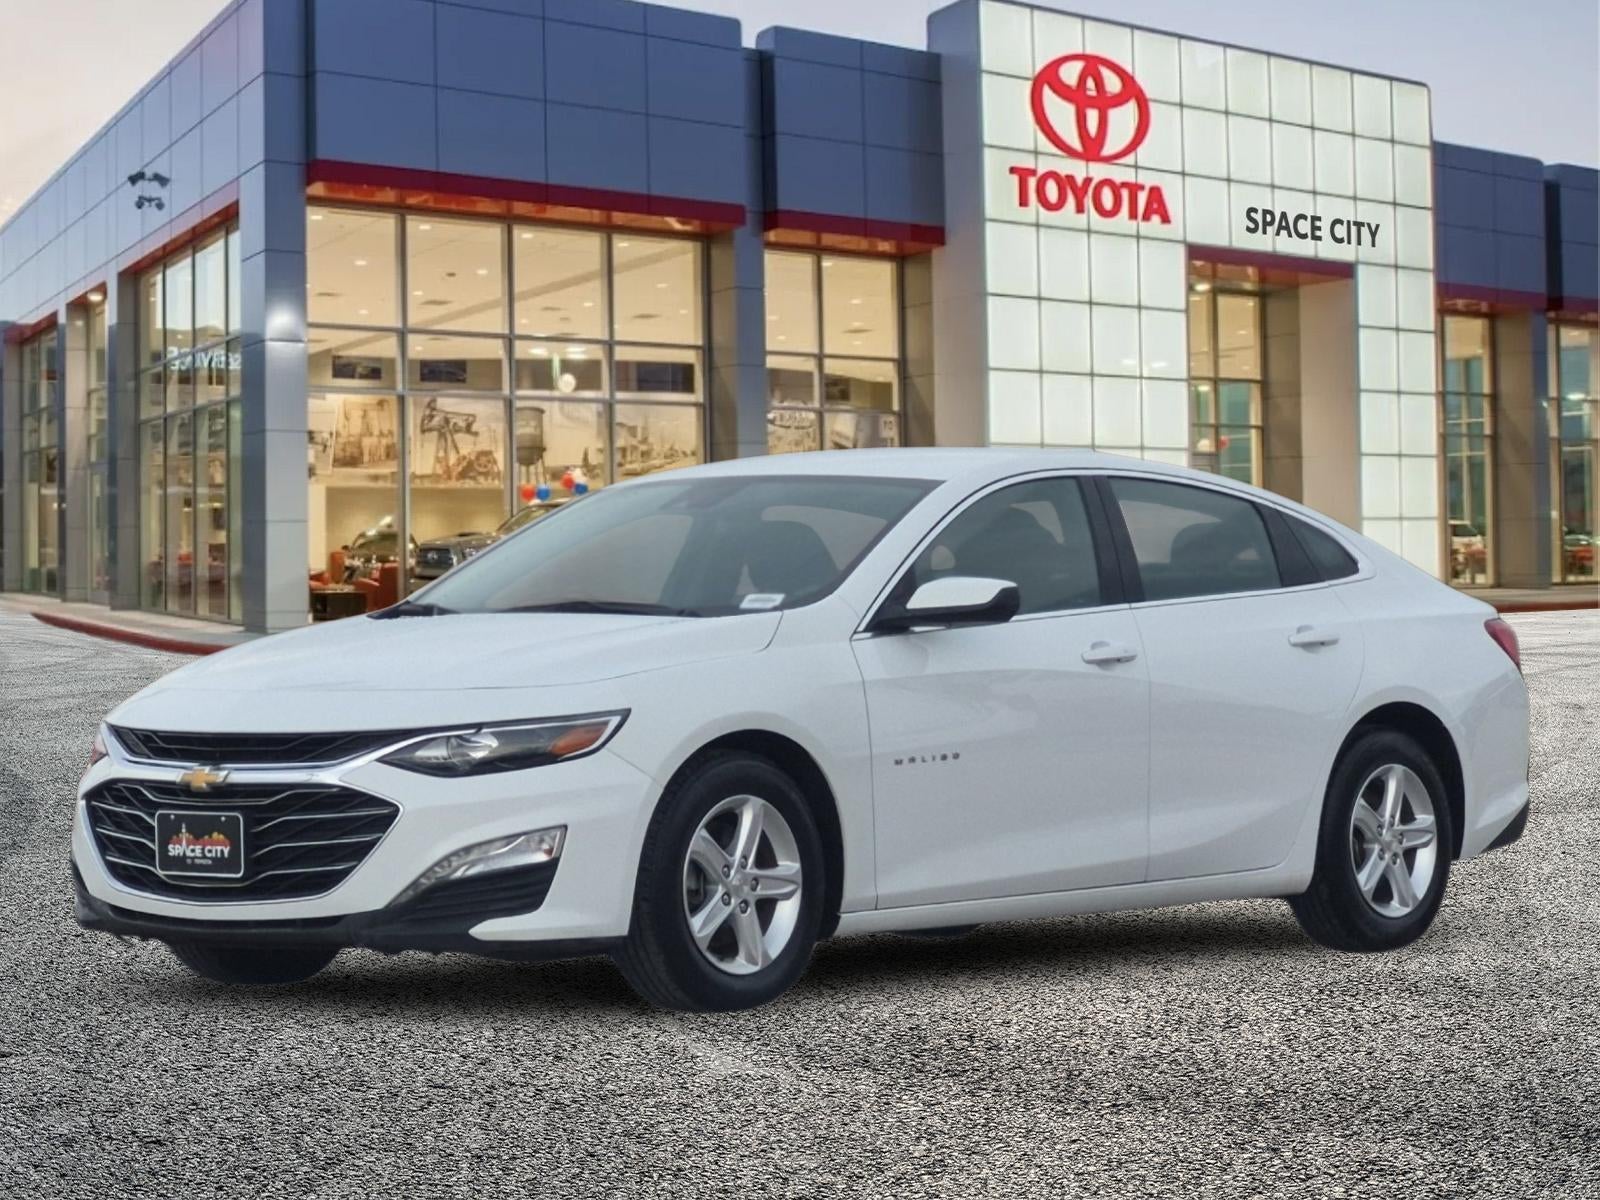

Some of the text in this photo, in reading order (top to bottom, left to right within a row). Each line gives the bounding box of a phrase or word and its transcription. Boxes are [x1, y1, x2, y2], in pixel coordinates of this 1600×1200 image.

[1009, 166, 1171, 224] TOYOTA
[1245, 206, 1381, 248] SPACE CITY
[167, 843, 231, 858] SPACE CITY
